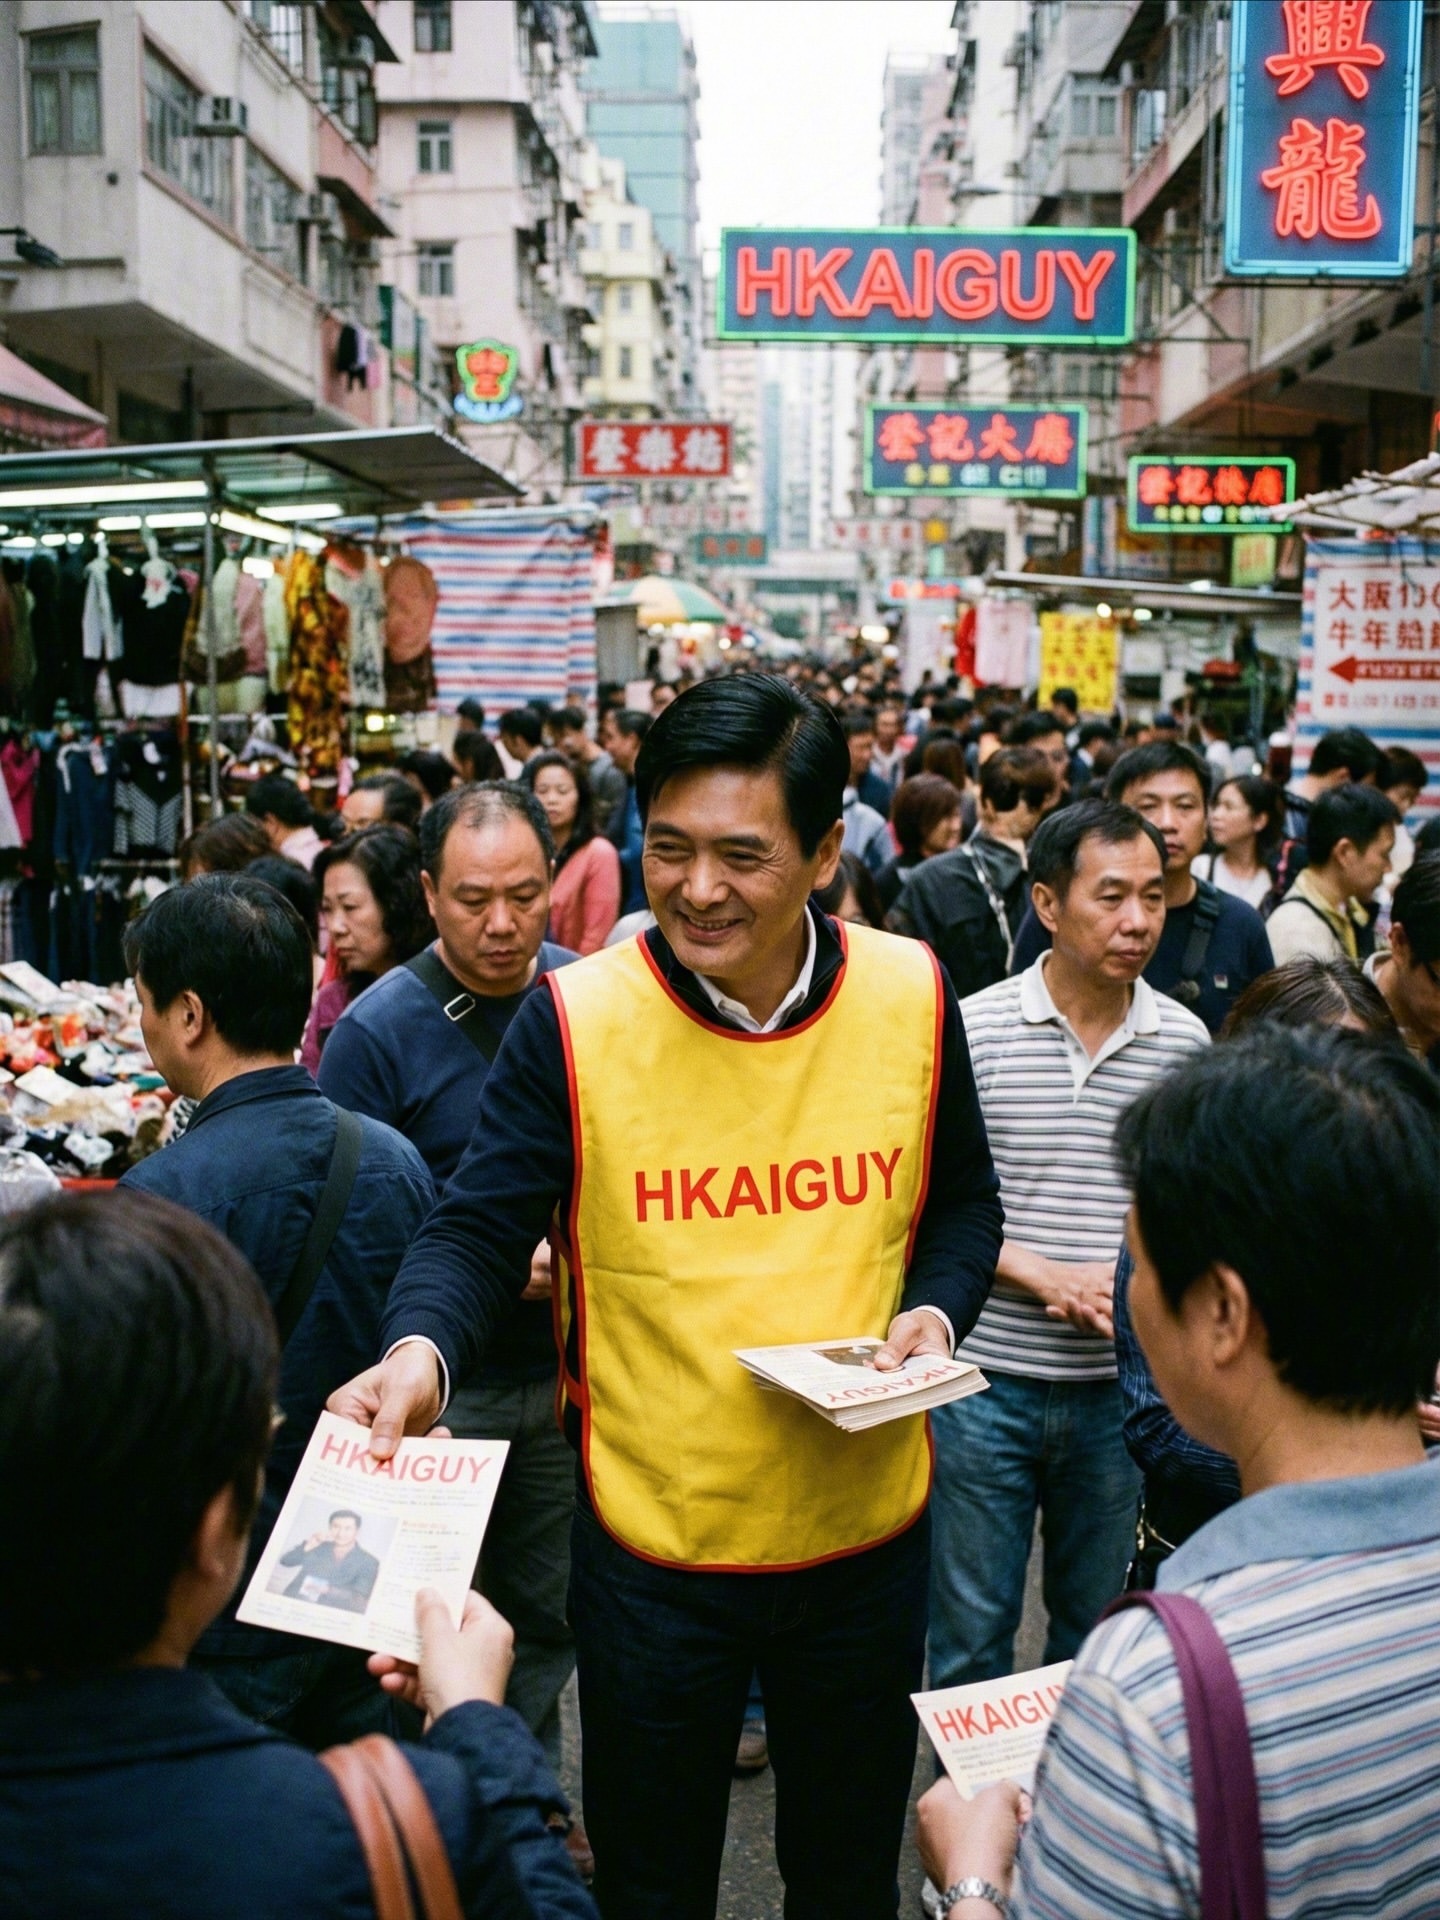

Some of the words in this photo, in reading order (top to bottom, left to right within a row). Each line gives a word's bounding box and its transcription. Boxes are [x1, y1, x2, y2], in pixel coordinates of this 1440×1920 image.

[736, 247, 1116, 321] HKAIGUY
[635, 1147, 904, 1223] HKAIGUY
[826, 1365, 960, 1403] HKAIGUY
[319, 1433, 492, 1484] HKAIGUY
[933, 1685, 1065, 1742] HKAIGU
